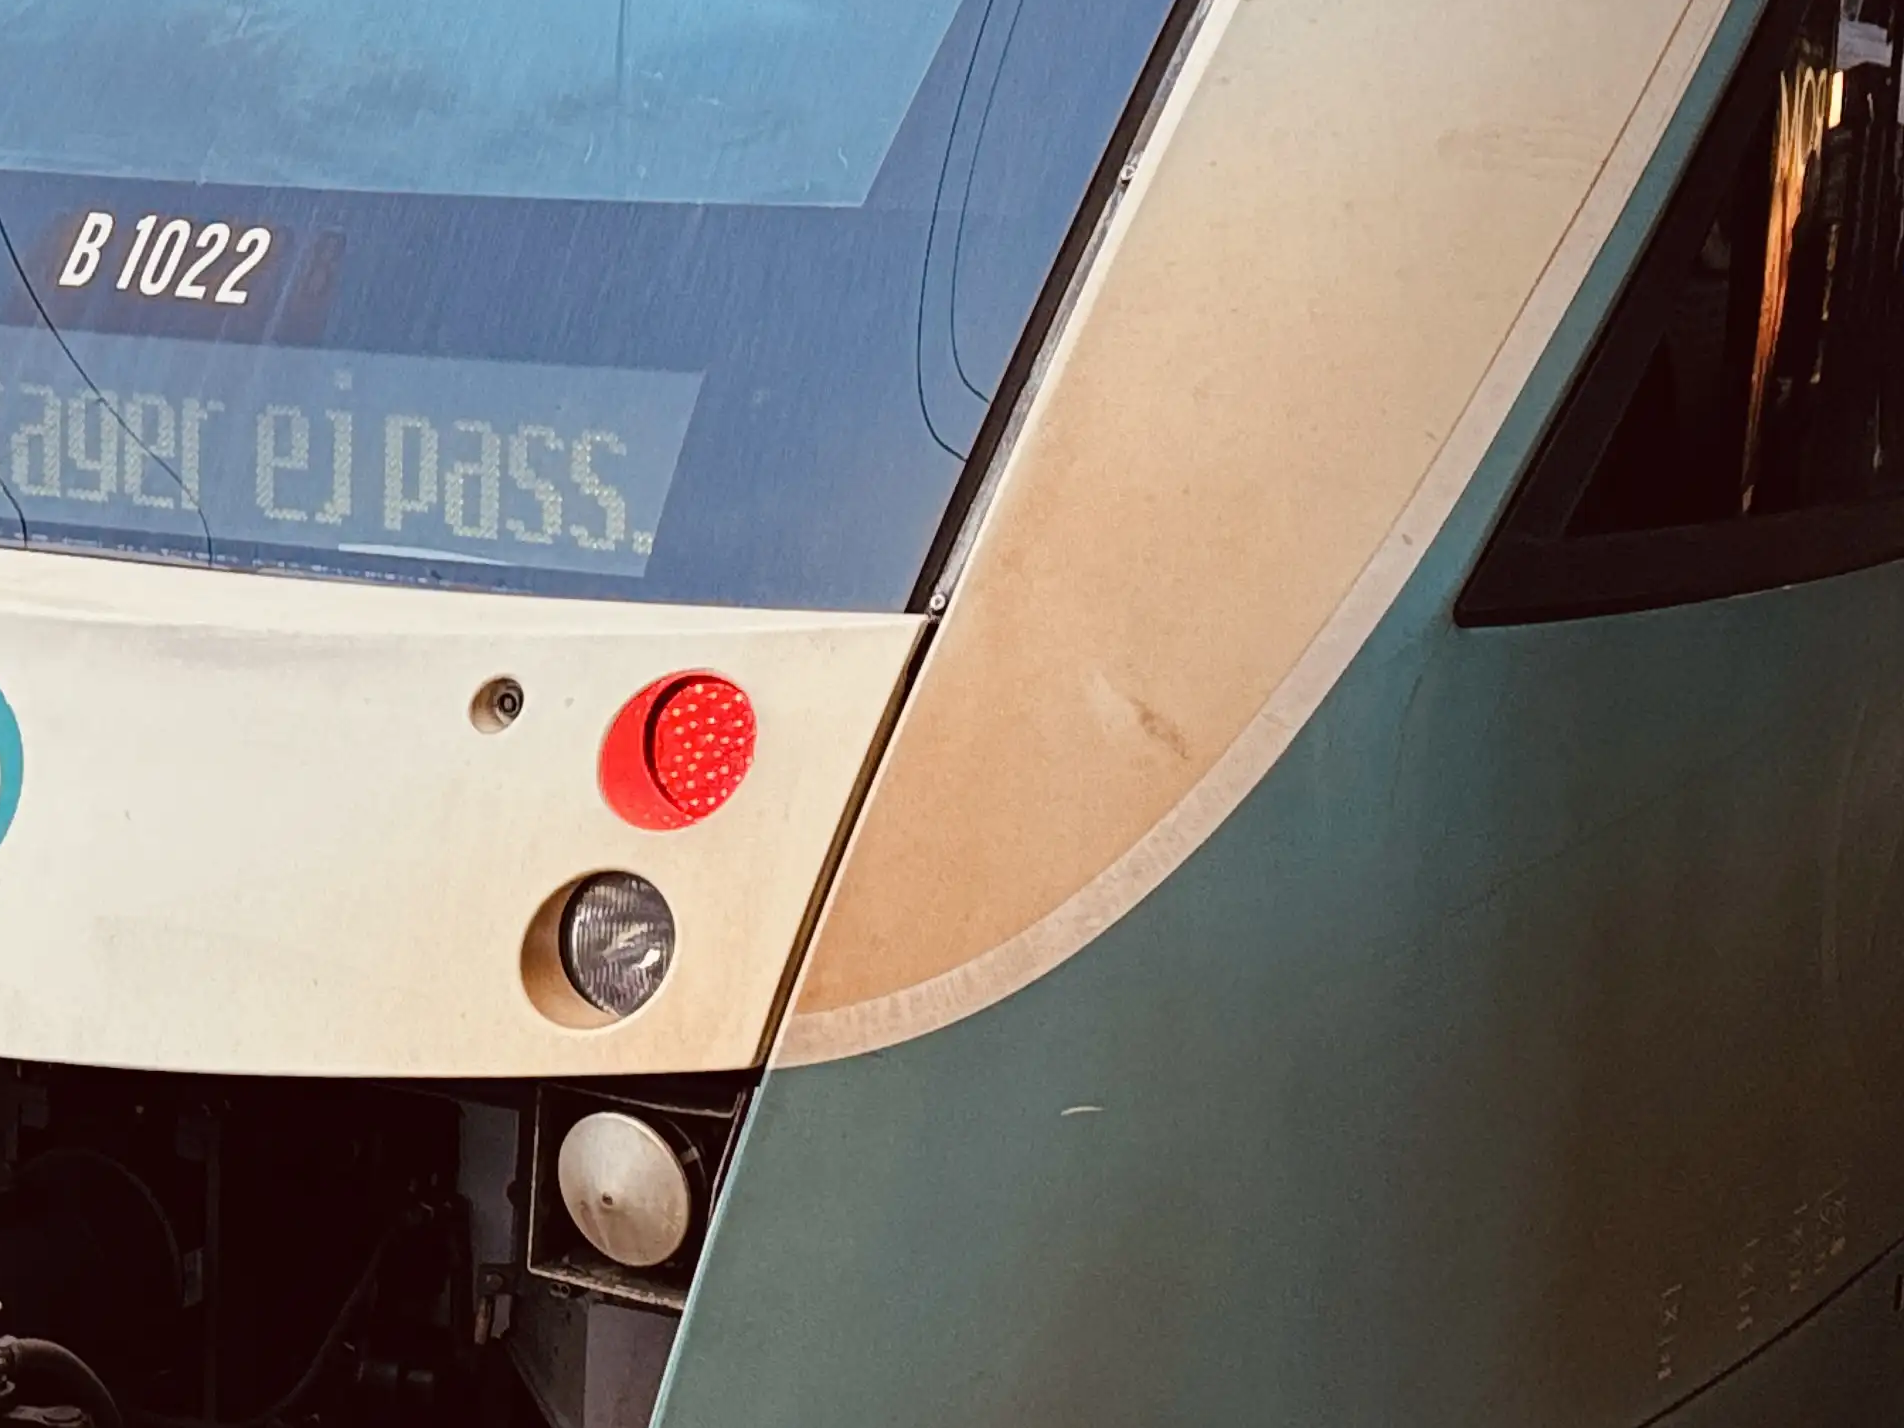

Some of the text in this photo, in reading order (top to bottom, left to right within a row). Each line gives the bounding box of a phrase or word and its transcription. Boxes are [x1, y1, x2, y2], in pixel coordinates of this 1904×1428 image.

[57, 212, 274, 305] B 1022
[254, 369, 355, 526] ej
[382, 412, 655, 556] pass.
